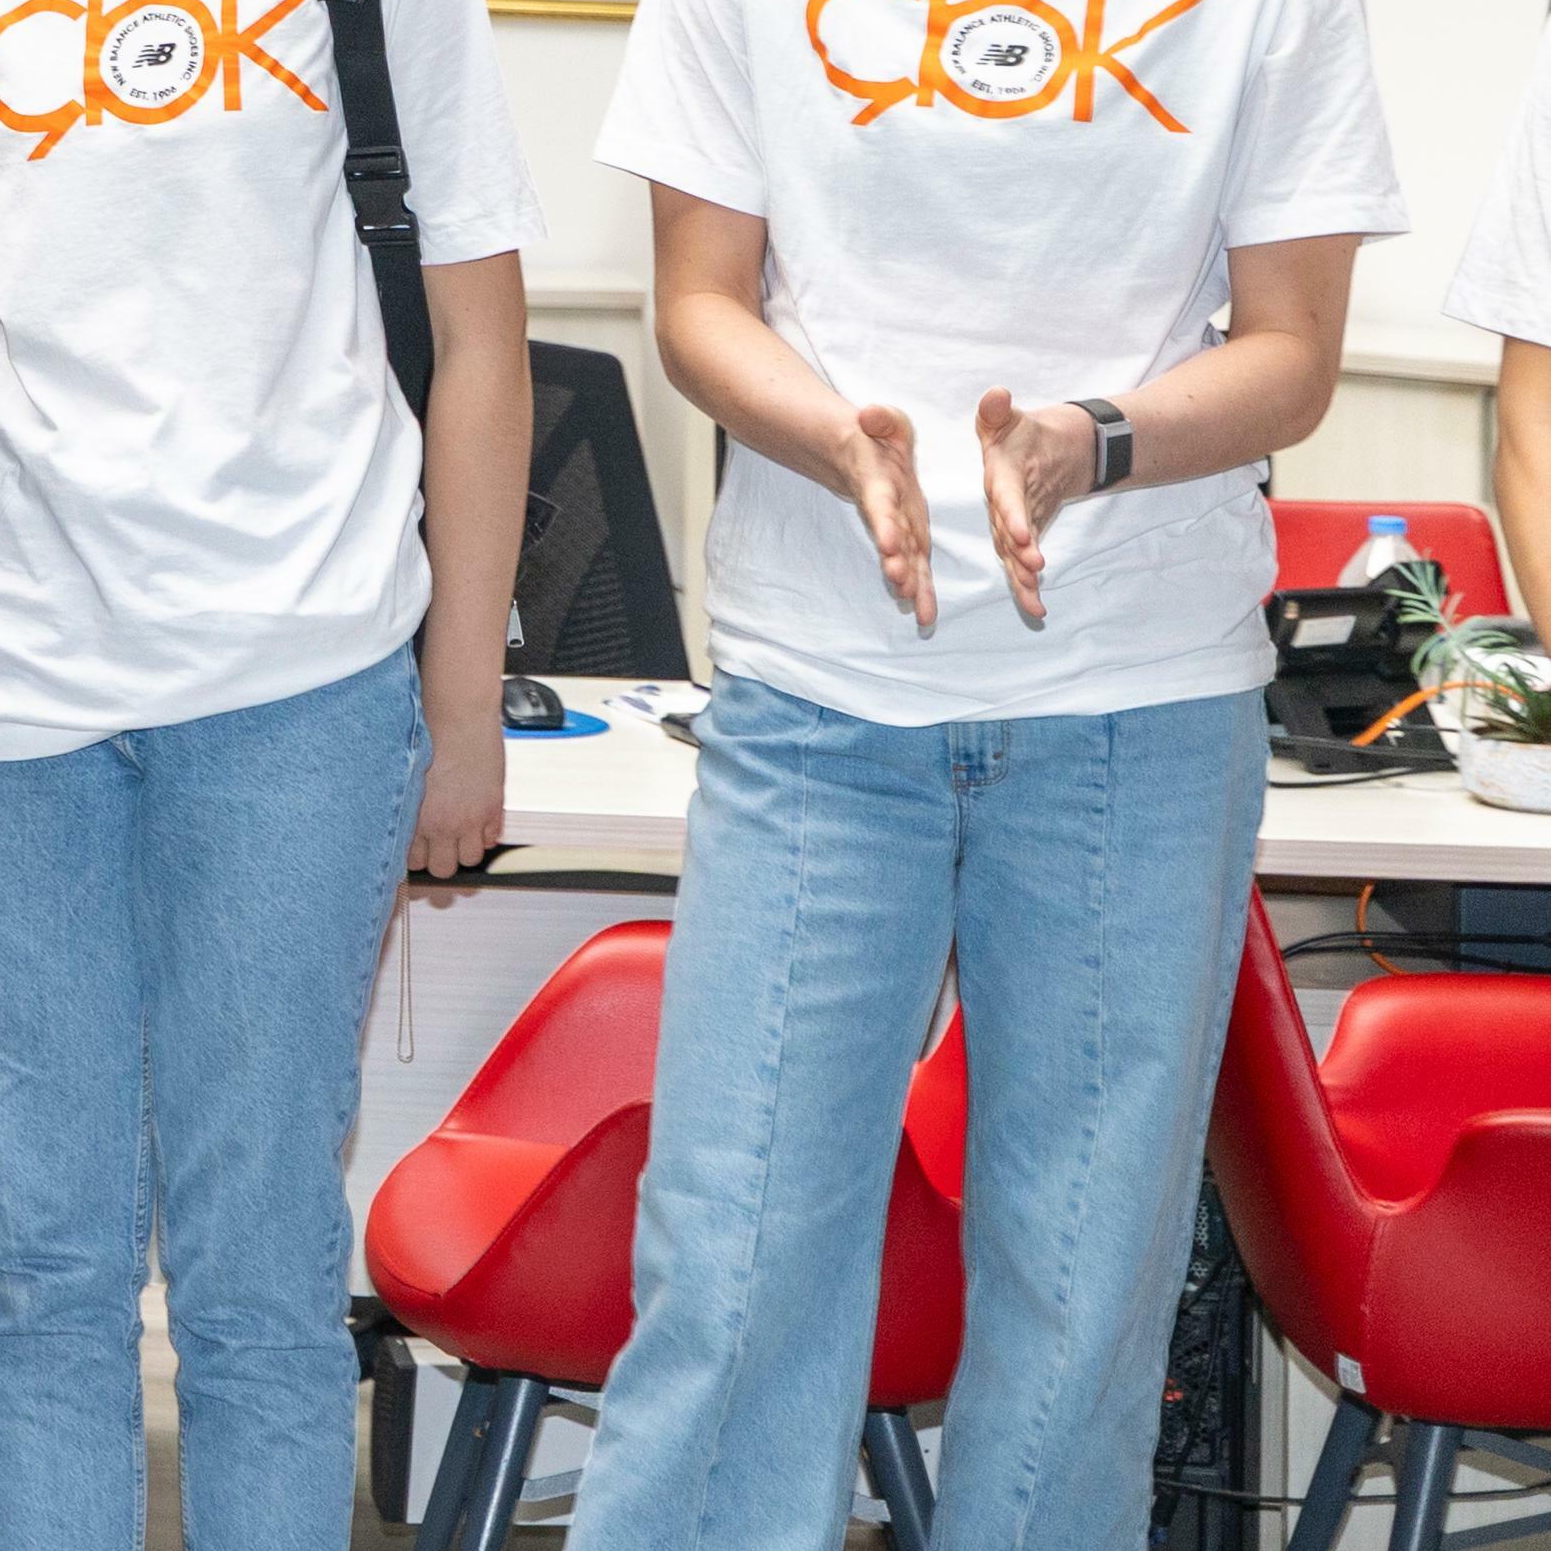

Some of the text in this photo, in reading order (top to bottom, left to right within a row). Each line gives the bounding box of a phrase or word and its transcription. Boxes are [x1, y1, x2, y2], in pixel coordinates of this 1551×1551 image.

[109, 20, 140, 61] BALANCE
[142, 13, 186, 27] ATHLETIC
[184, 25, 199, 57] SHOES
[990, 14, 1041, 31] ATHLETIC
